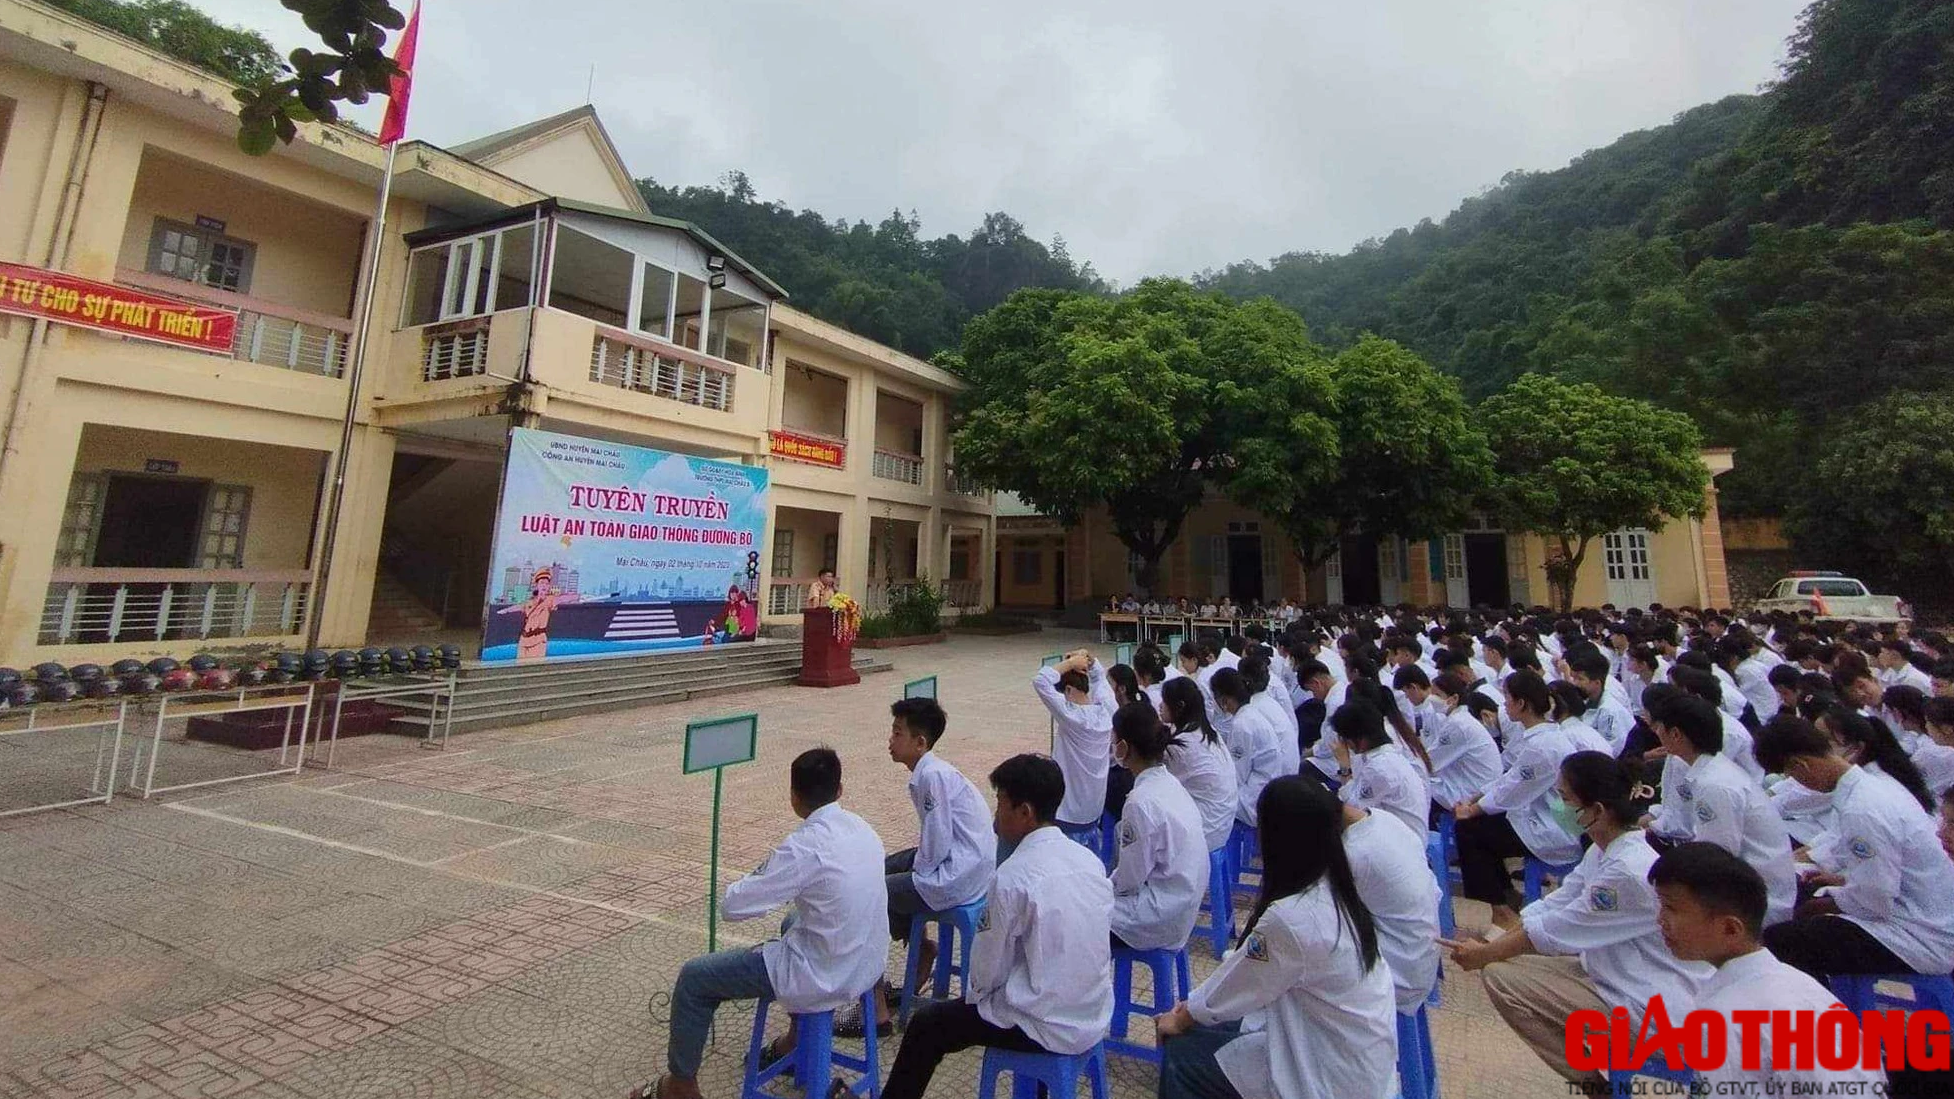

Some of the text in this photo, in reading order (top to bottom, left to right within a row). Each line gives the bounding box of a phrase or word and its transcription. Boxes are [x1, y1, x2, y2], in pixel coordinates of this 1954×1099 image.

[12, 278, 41, 304] TƯ
[40, 284, 80, 314] CHO
[82, 293, 112, 323] SỰ
[110, 299, 157, 329] PHÁT
[159, 306, 204, 339] TRIỂN
[570, 485, 730, 520] TUYÊN TRUYỀN
[521, 513, 561, 537] LUẬT
[563, 518, 586, 536] AN
[589, 518, 625, 538] TOÀN
[628, 523, 658, 540] GIAO
[661, 524, 699, 543] THÔNG
[615, 556, 629, 567] Mai
